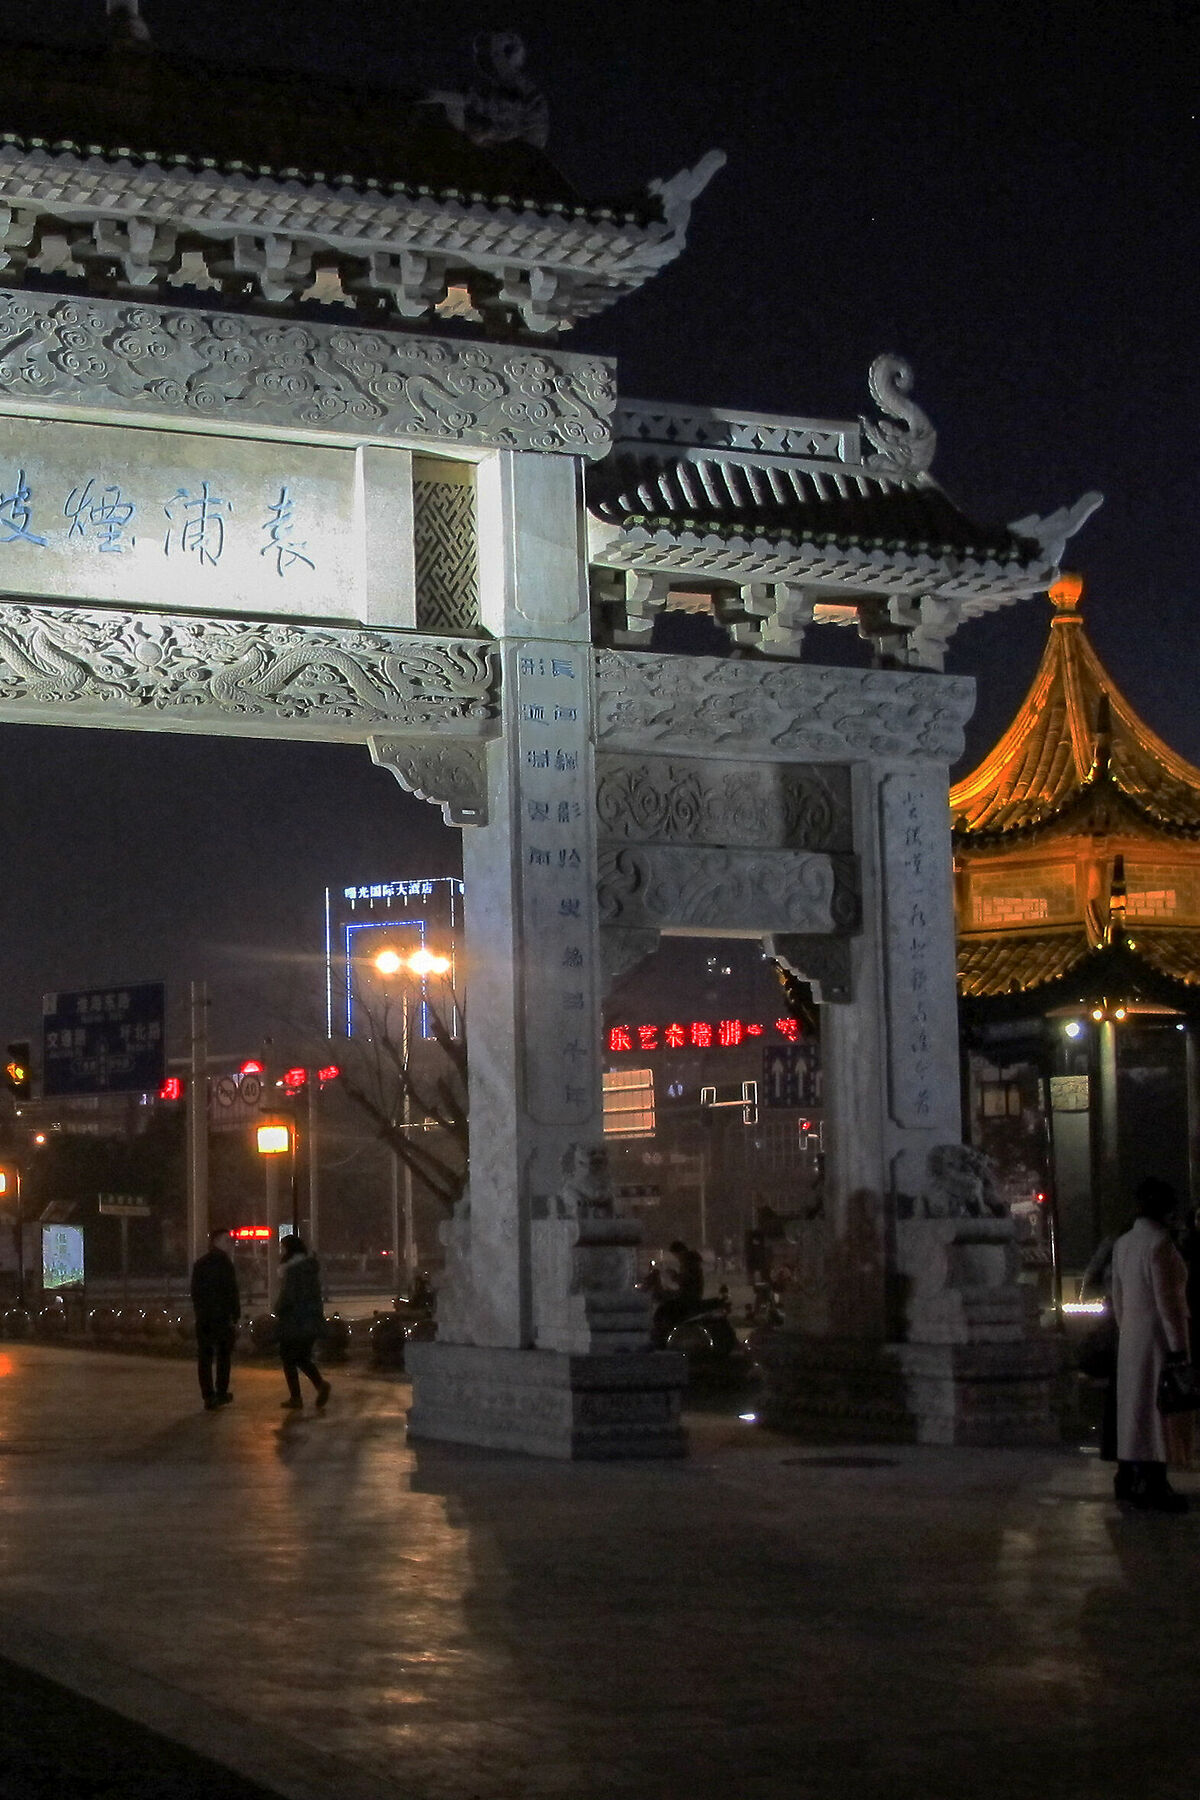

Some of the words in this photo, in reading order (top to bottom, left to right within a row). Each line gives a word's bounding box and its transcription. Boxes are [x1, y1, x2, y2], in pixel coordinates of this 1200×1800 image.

[344, 882, 433, 899] 曙光国际大酒店
